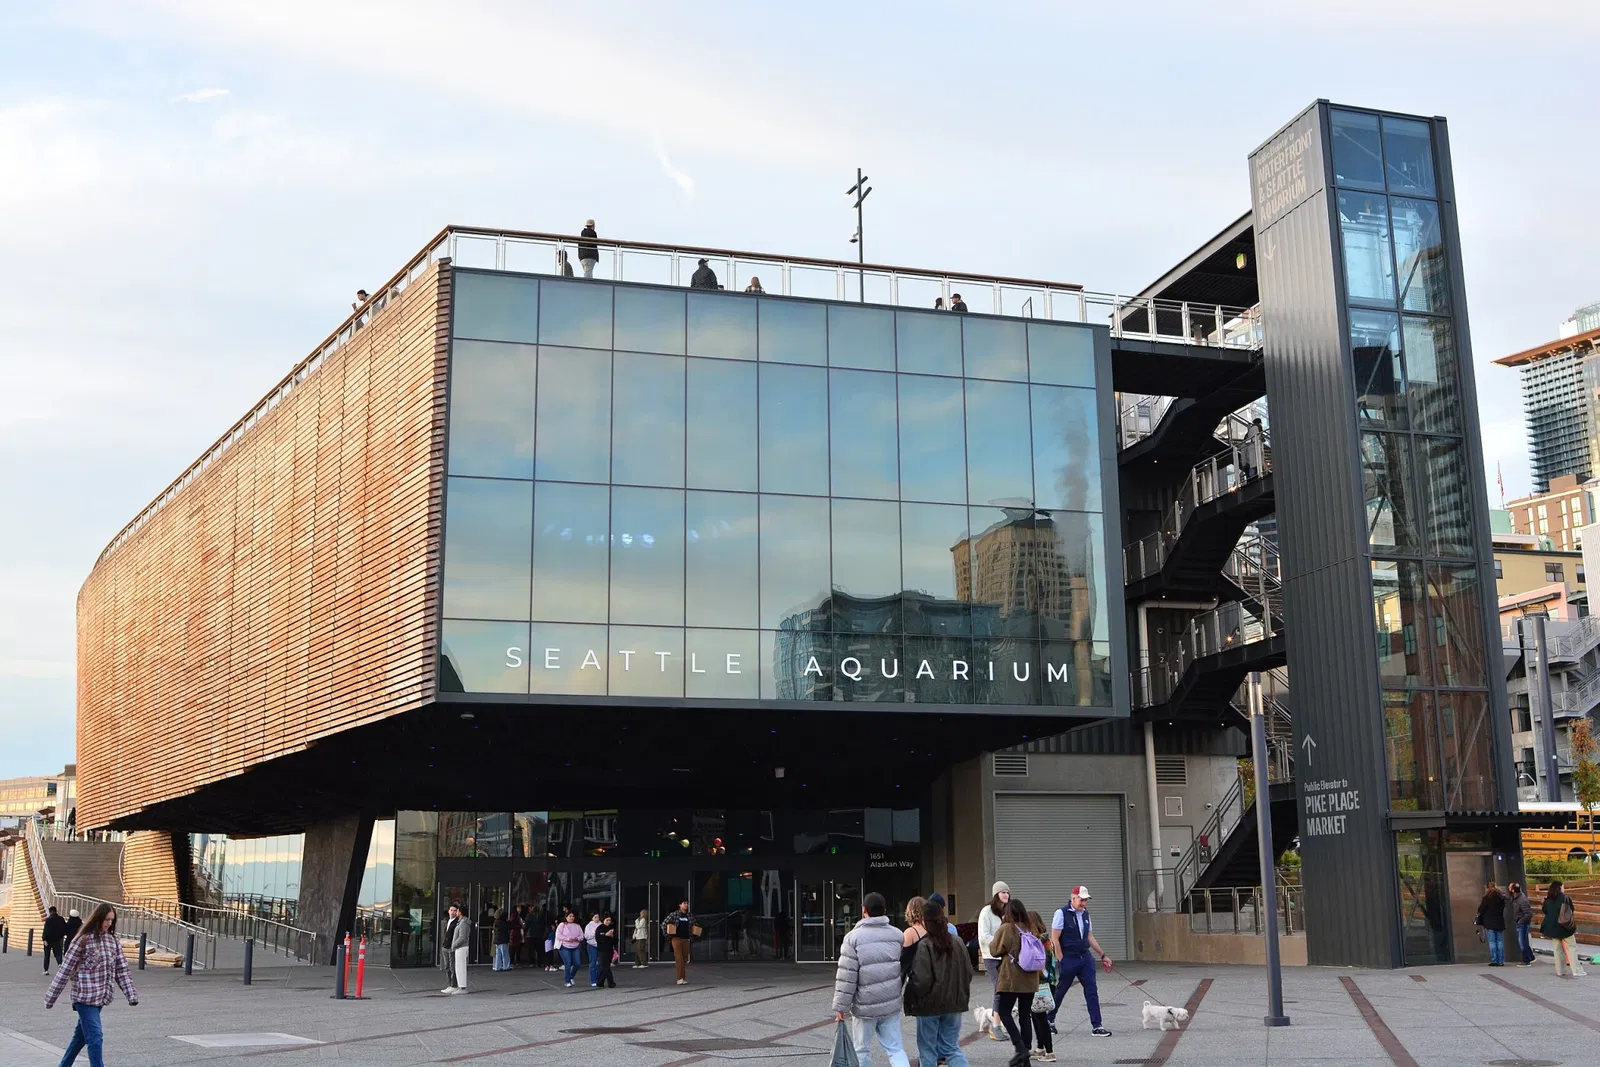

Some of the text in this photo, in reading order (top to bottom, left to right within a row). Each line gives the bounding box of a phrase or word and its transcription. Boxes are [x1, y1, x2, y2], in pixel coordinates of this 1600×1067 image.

[1258, 129, 1312, 184] WATERFRONT
[1258, 158, 1304, 204] & SEATTLE
[1260, 176, 1306, 223] AQUARIUM
[505, 646, 1068, 684] SEATTLE AQUARIUM
[1304, 778, 1348, 792] Public Elevator to
[1305, 790, 1360, 814] PIKE PLACE
[1306, 815, 1346, 836] MARKET
[899, 860, 914, 868] Way
